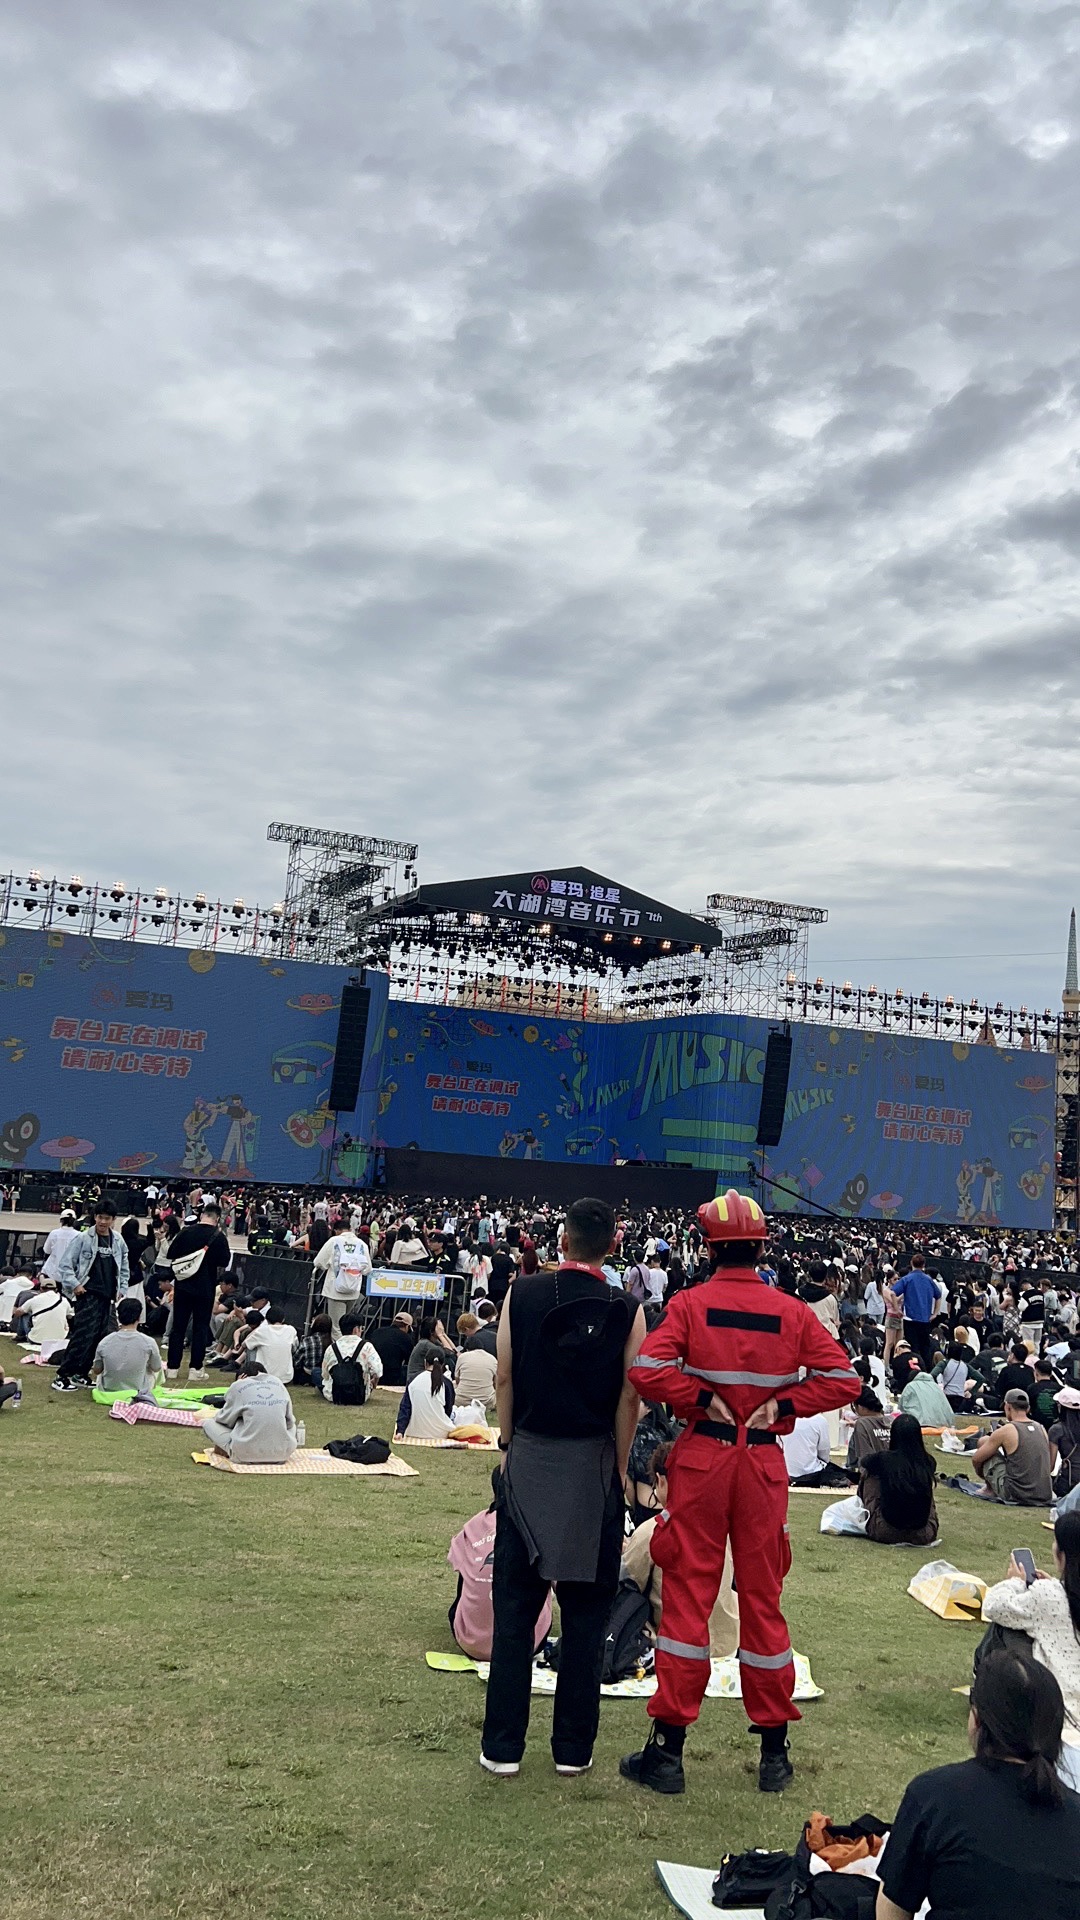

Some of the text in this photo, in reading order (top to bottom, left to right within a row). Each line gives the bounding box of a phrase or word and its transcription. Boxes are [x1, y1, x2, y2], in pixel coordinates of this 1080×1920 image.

[492, 890, 663, 927] 太湖湾音乐节 7th
[125, 990, 174, 1011] 爱玛
[50, 1016, 208, 1052] 舞台正在调试
[61, 1046, 192, 1078] 请耐心等待
[425, 1073, 520, 1096] 舞台正在调试
[432, 1096, 511, 1116] 请耐心等待
[875, 1100, 972, 1127] 舞台正在调试
[882, 1121, 964, 1146] 请耐心等待
[399, 1278, 437, 1294] 卫生间
